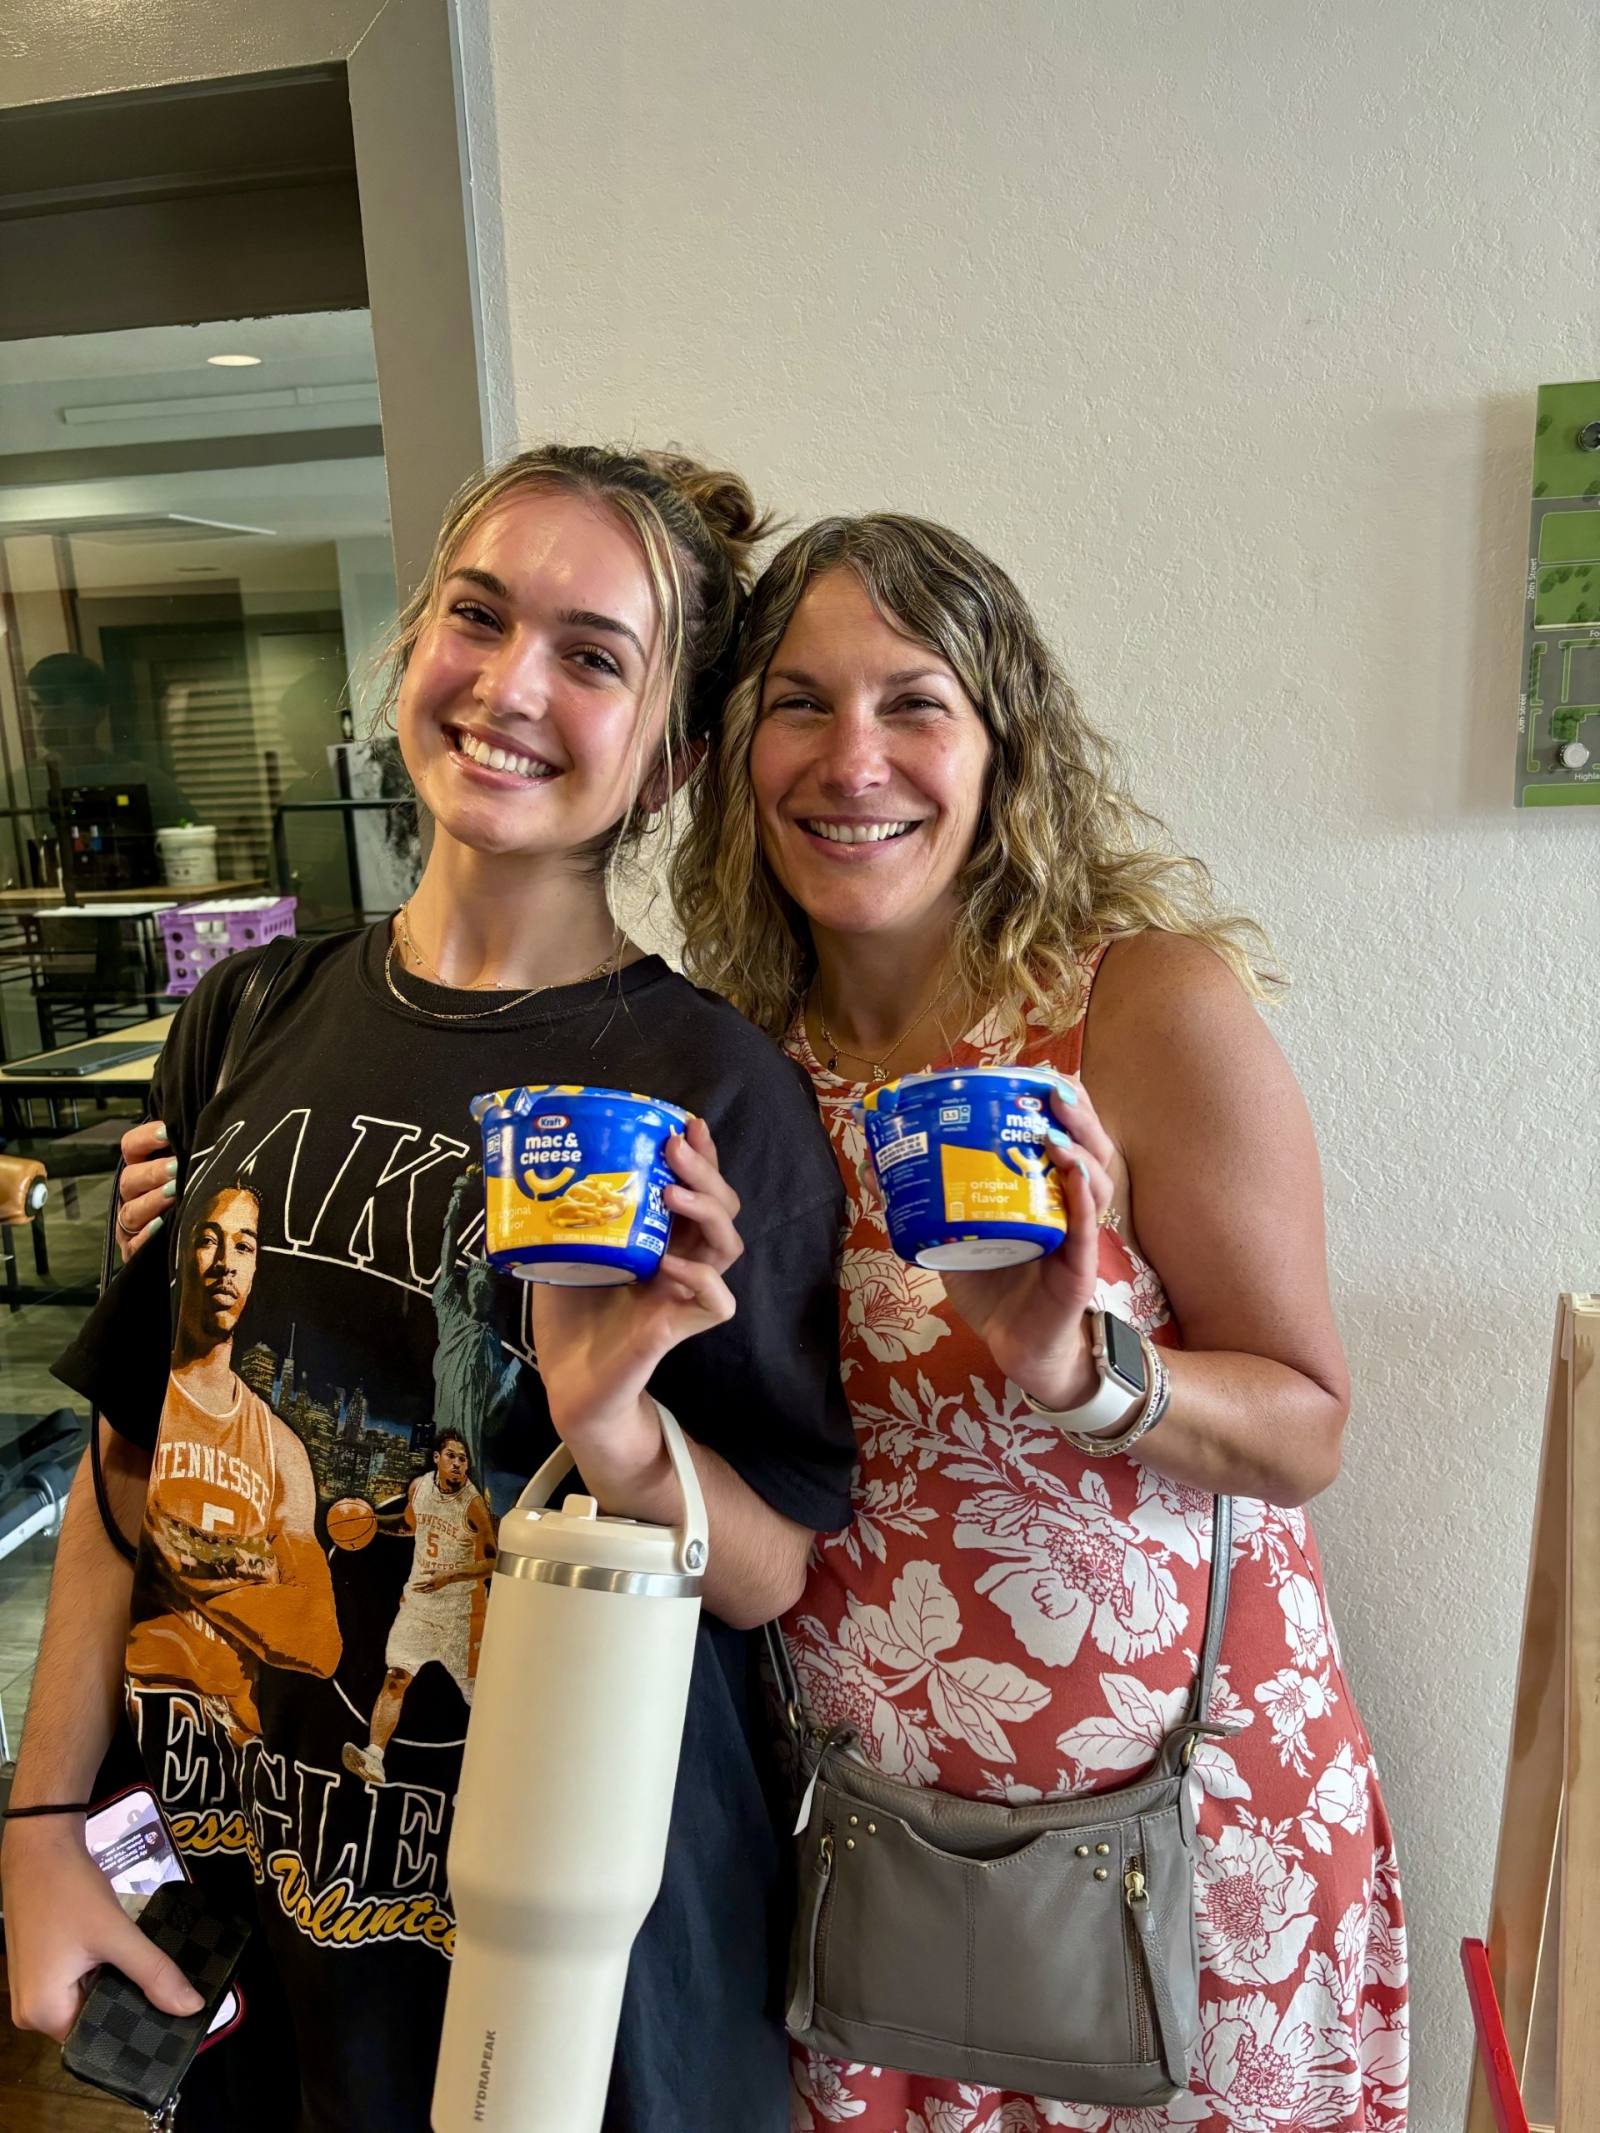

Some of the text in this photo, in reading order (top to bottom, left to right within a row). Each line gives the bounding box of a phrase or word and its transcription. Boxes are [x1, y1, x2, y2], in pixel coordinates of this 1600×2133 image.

[1528, 557, 1538, 600] 20th Street
[1518, 692, 1528, 714] Street
[1574, 772, 1600, 782] Highla
[540, 1117, 562, 1128] Kraft
[525, 1133, 578, 1150] mac &
[970, 1178, 1018, 1193] original
[970, 1192, 1010, 1204] flavor
[427, 1532, 439, 1558] 5
[473, 2029, 496, 2123] HYDRAPEAK
